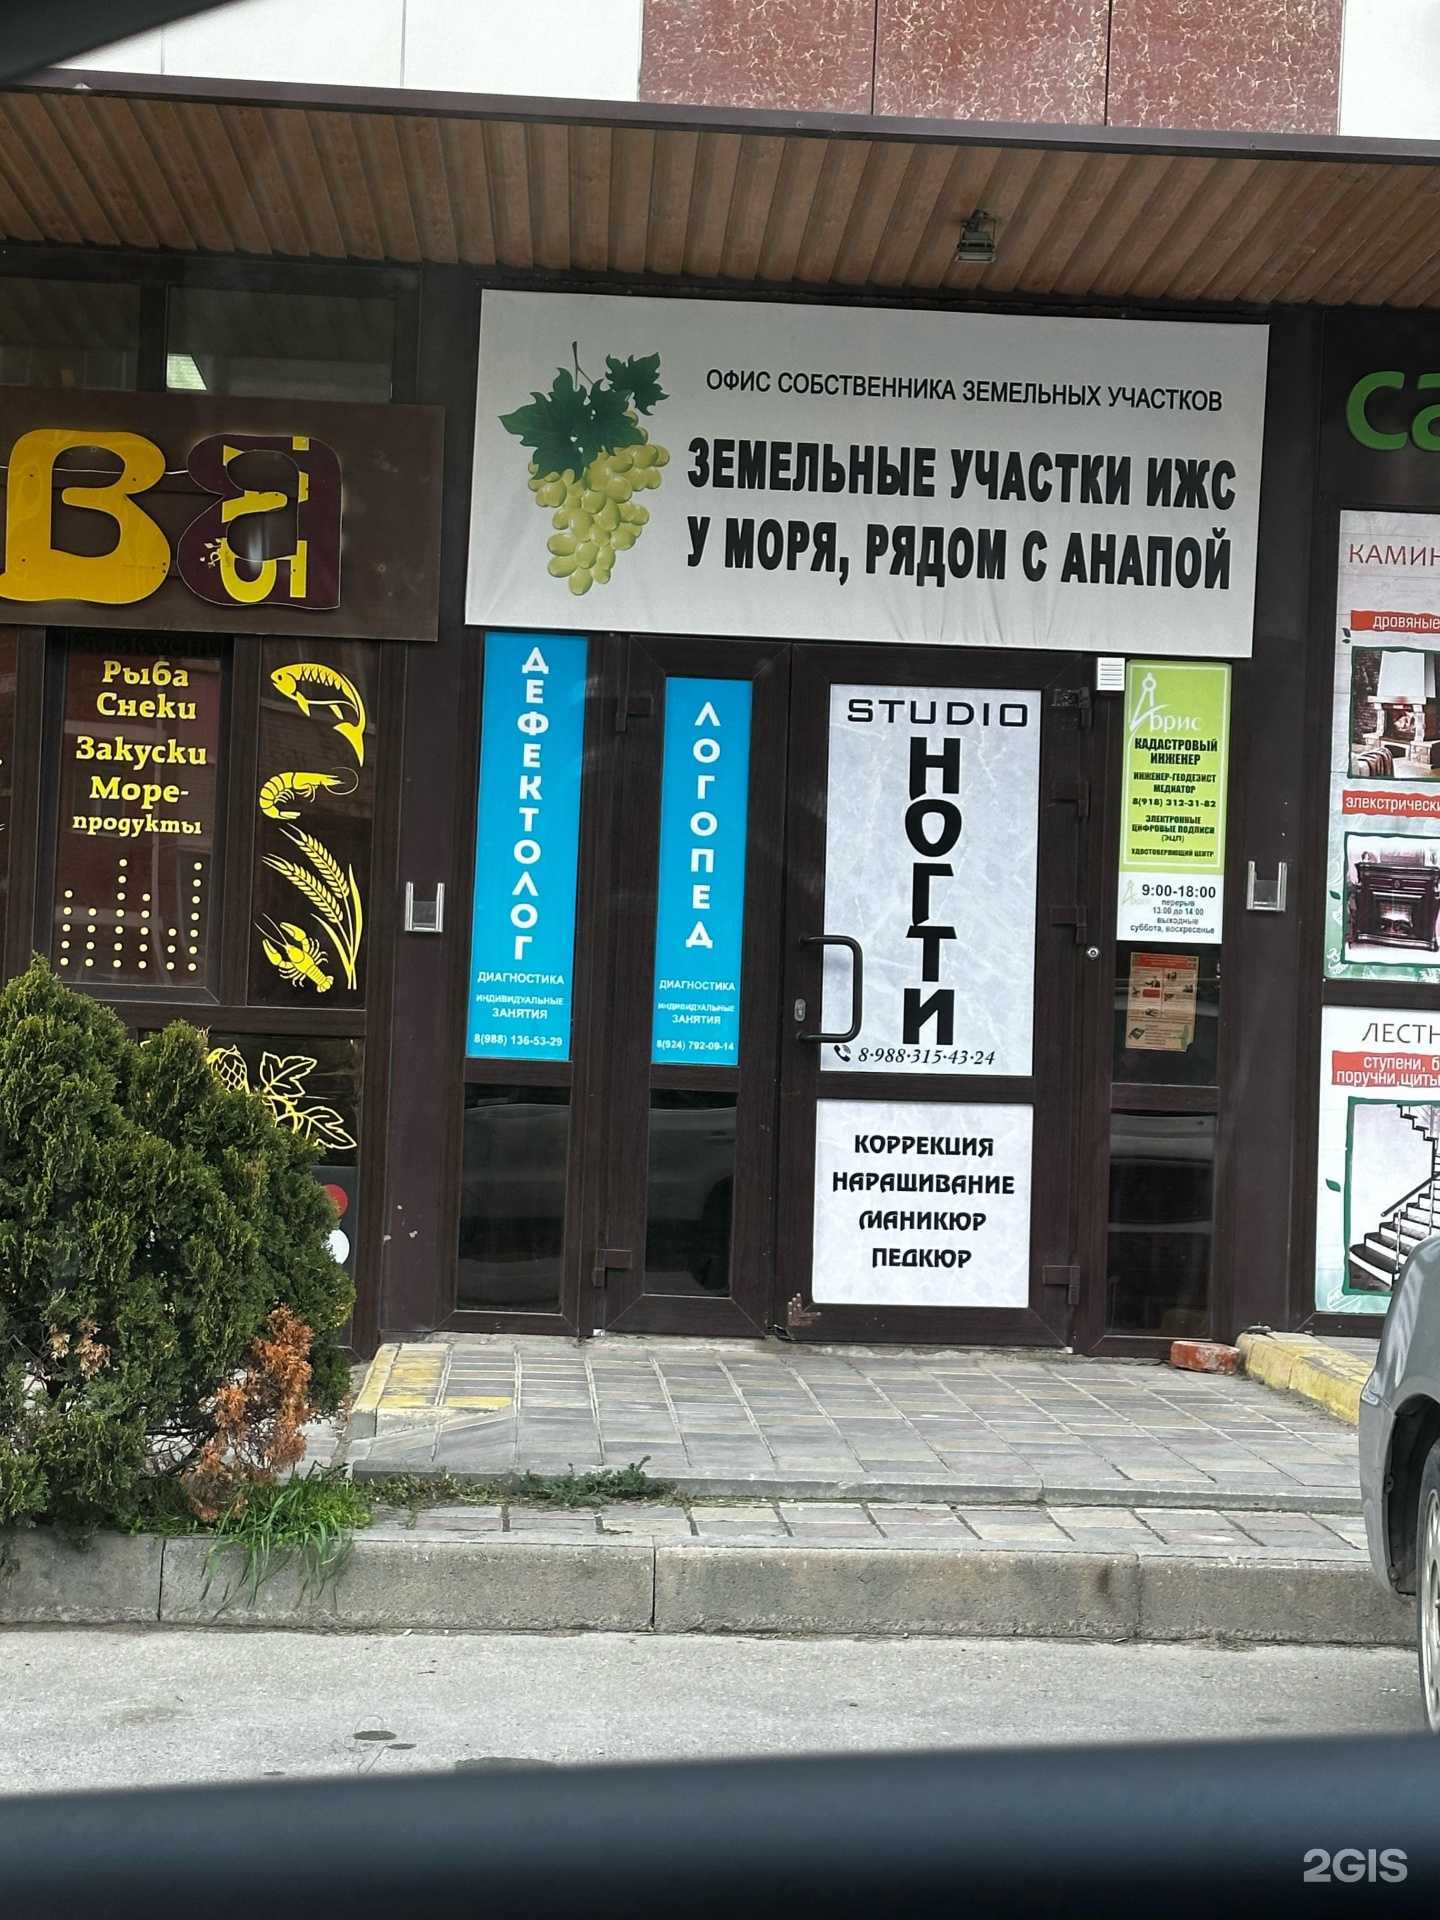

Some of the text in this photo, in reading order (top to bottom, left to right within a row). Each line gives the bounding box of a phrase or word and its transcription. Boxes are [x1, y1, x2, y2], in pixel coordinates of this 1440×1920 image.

[706, 369, 1222, 411] ОФИС СОБСТВЕННИКА ЗЕМЕЛЬНЫХ УЧАСТКОВ
[687, 437, 1236, 510] ЗЕМЕЛЬНЫЕ УЧАСТКИ ИЖС
[687, 516, 1232, 590] У МОРЯ, РЯДОМ С АНАПОЙ
[101, 660, 190, 688] Рыба
[96, 692, 197, 720] Снеки
[847, 699, 1028, 727] STUDIO
[76, 735, 207, 771] Закуски
[1134, 738, 1218, 752] КАДАСТРОВЫЙ
[1150, 752, 1200, 766] ИНЖЕНЕР
[89, 776, 189, 810] Море-
[1153, 784, 1196, 793] МЕДИАТОР
[510, 646, 549, 960] ДЕФЕКТОЛОГ
[72, 813, 202, 838] продукты
[685, 701, 721, 949] ЛОГОПЕД
[902, 736, 962, 1045] НОГТИ
[1142, 884, 1216, 898] 9:00-18:00
[477, 972, 565, 985] ДИАГНОСТИКА
[659, 979, 736, 991] ДИАГНОСТИКА
[491, 1007, 548, 1019] ЗАНЯТИЯ
[671, 1014, 721, 1024] ЗАНЯТИЯ
[1363, 1056, 1427, 1072] ступени,
[854, 1134, 994, 1158] КОРРЕКЦИЯ
[858, 1210, 987, 1232] МАНИКЮР
[872, 1248, 972, 1269] ПЕДКЮР
